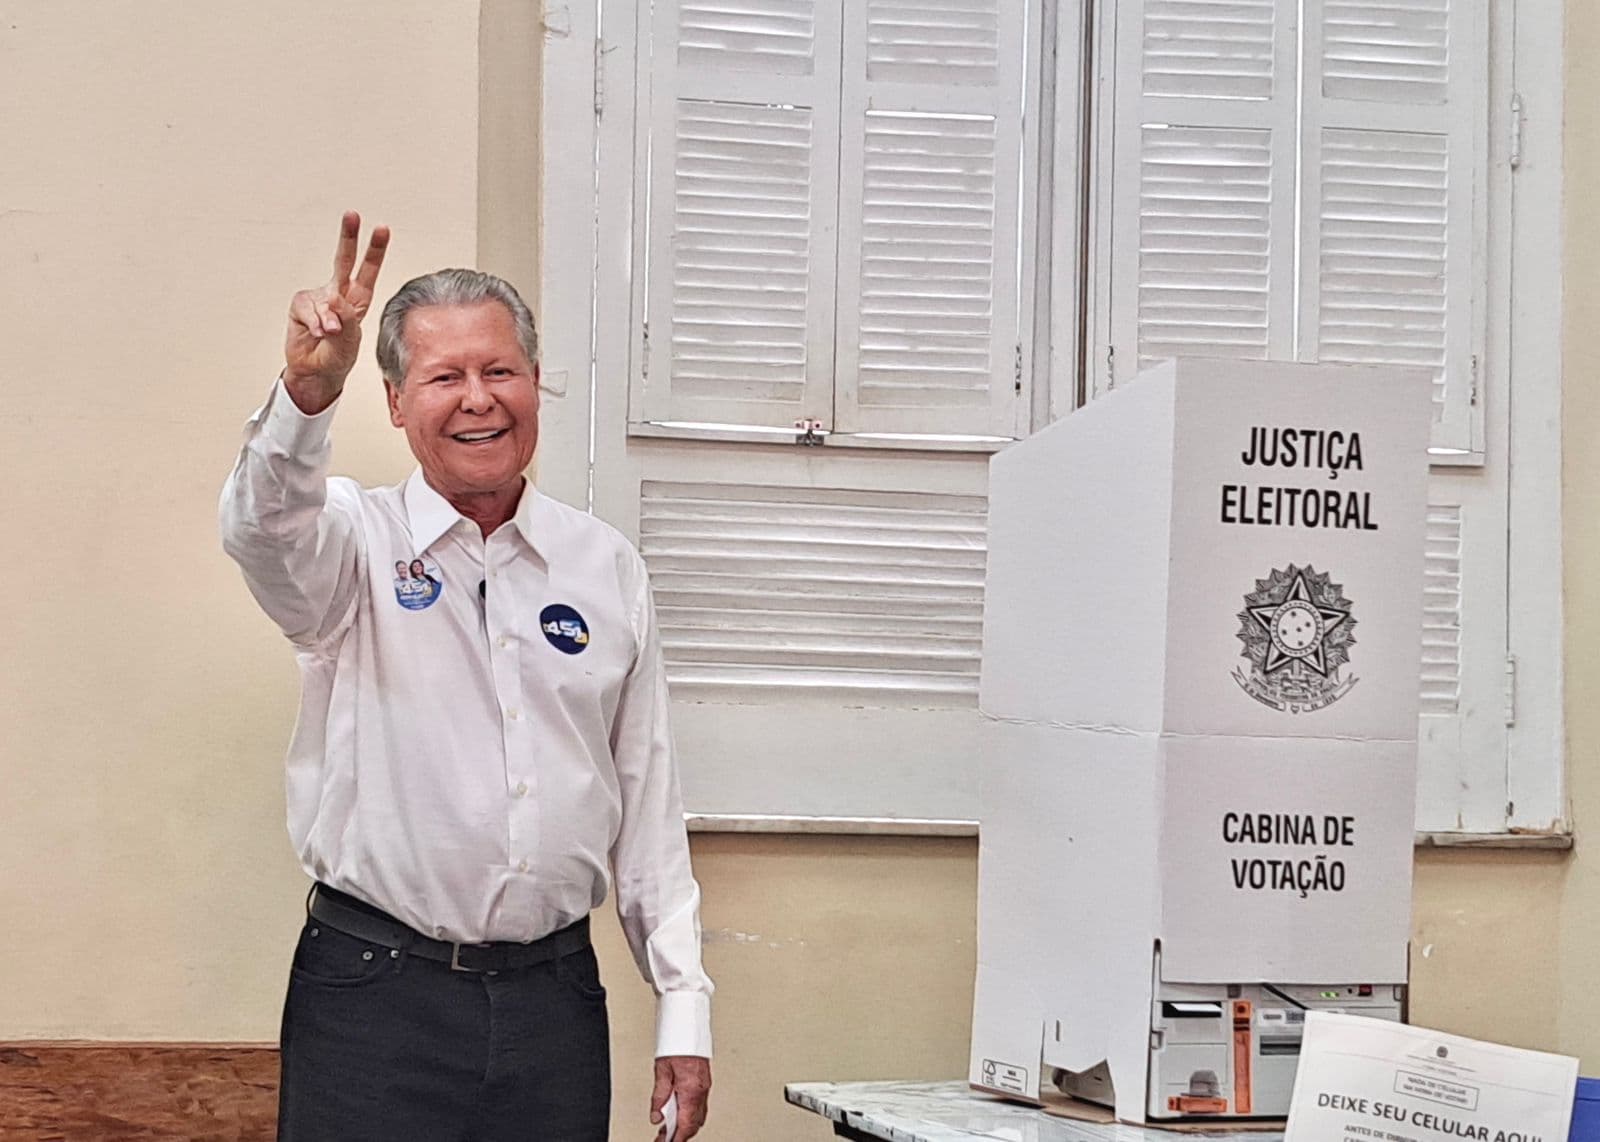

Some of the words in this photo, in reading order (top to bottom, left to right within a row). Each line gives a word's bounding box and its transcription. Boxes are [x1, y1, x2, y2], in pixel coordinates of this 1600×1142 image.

[1241, 426, 1363, 480] JUSTIÇA
[1220, 484, 1379, 530] ELEITORAL
[1222, 811, 1317, 845] CABINA
[1323, 815, 1355, 846] DE
[1231, 855, 1345, 899] VOTAÇÃO
[1317, 1092, 1369, 1114] DEIXE
[1372, 1102, 1407, 1122] SEU
[1411, 1111, 1490, 1142] CELULAR
[1344, 1124, 1371, 1137] ANTES
